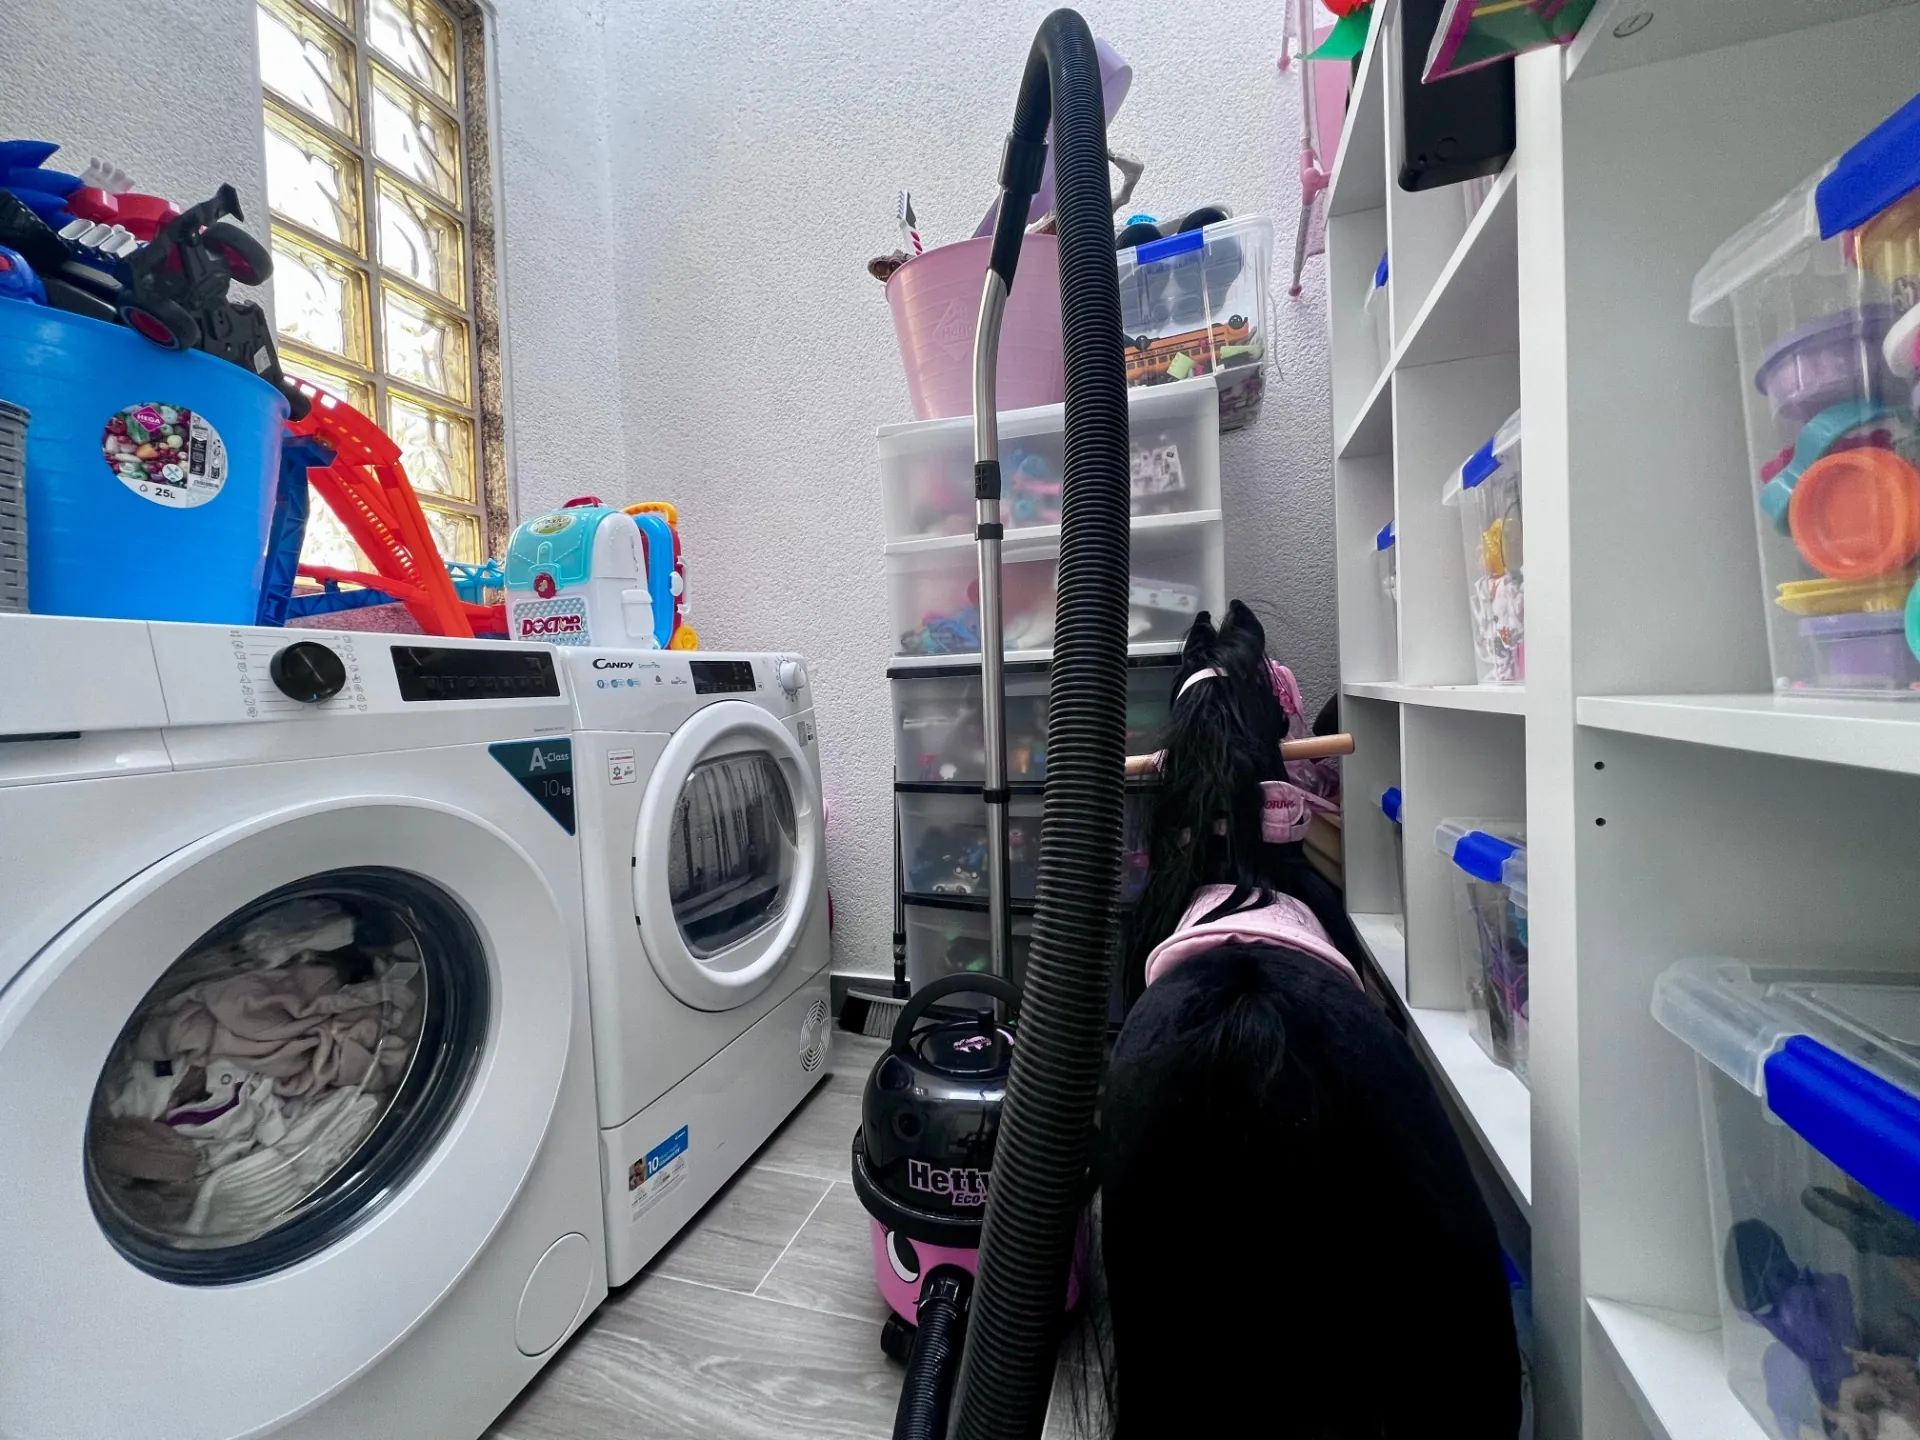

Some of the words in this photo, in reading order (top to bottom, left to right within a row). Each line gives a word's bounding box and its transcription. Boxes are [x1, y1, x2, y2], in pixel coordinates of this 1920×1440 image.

[136, 413, 162, 425] HEGA
[521, 614, 584, 637] DOCTOR
[592, 658, 634, 670] CANDY
[542, 779, 560, 797] 10
[561, 785, 571, 796] kg
[647, 1156, 660, 1174] 10
